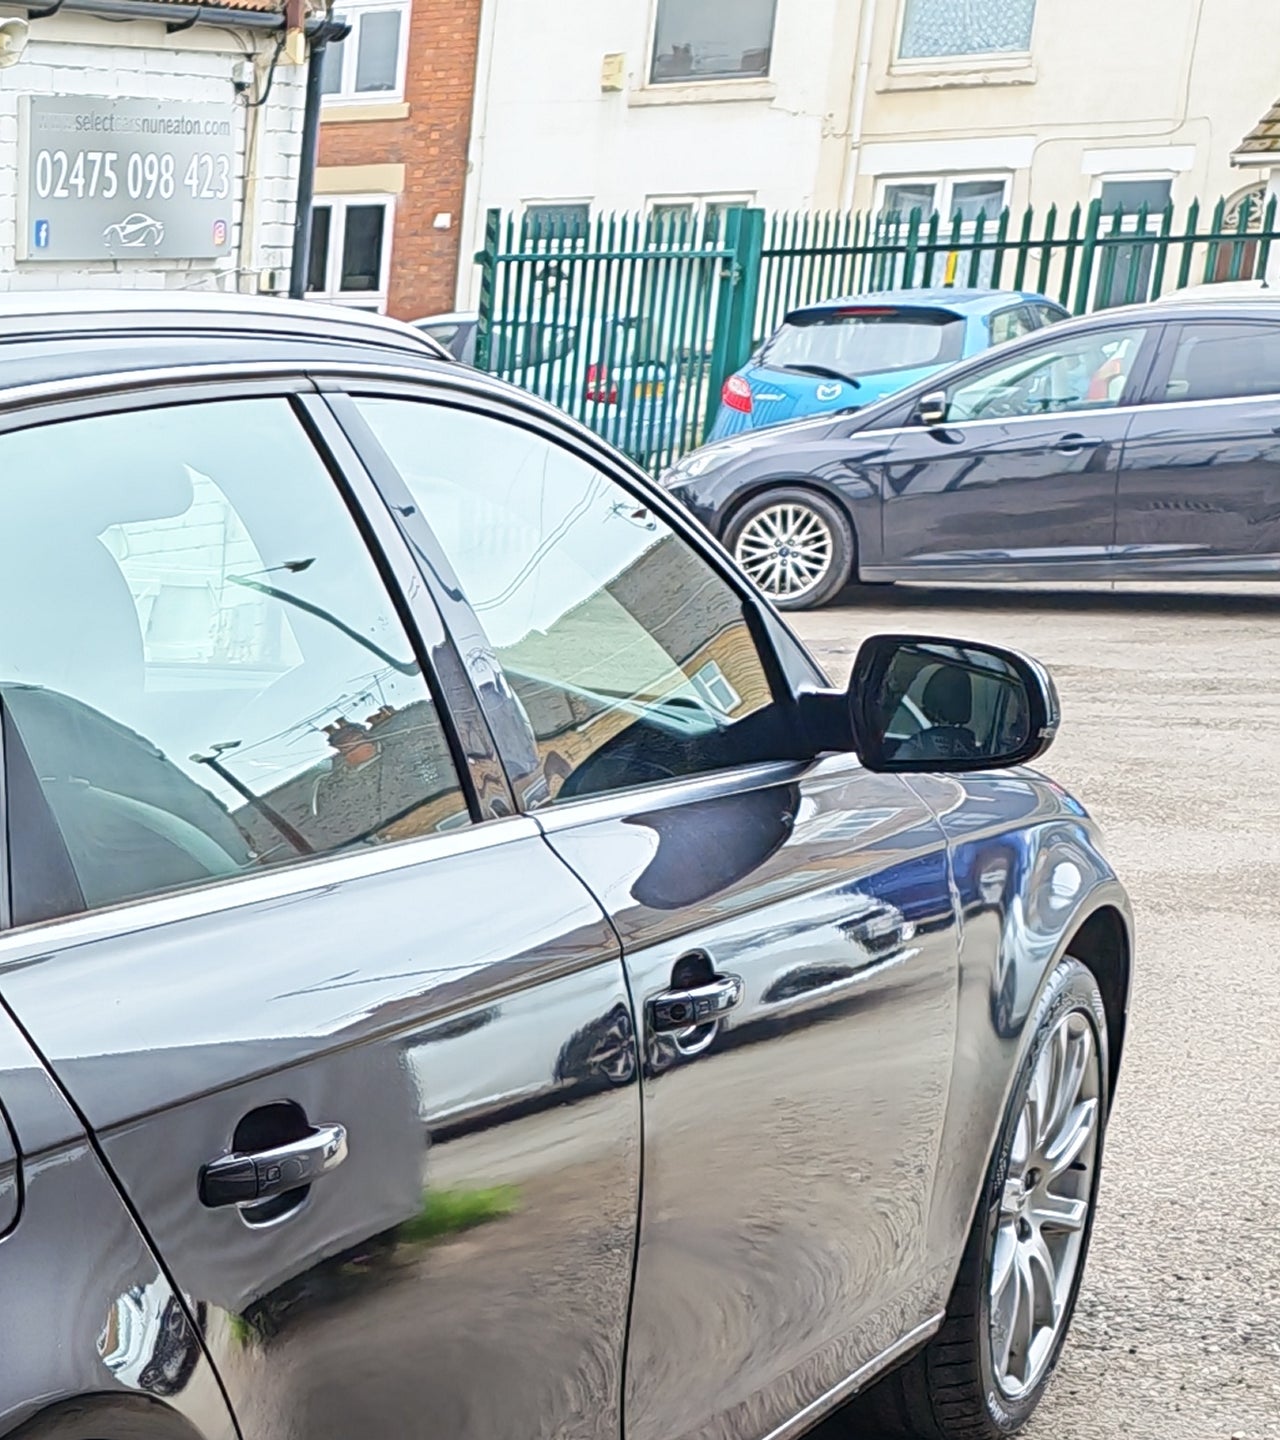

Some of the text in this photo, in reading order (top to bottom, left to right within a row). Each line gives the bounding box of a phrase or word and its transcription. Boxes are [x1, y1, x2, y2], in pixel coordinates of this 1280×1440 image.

[35, 150, 230, 199] 02475 098 423
